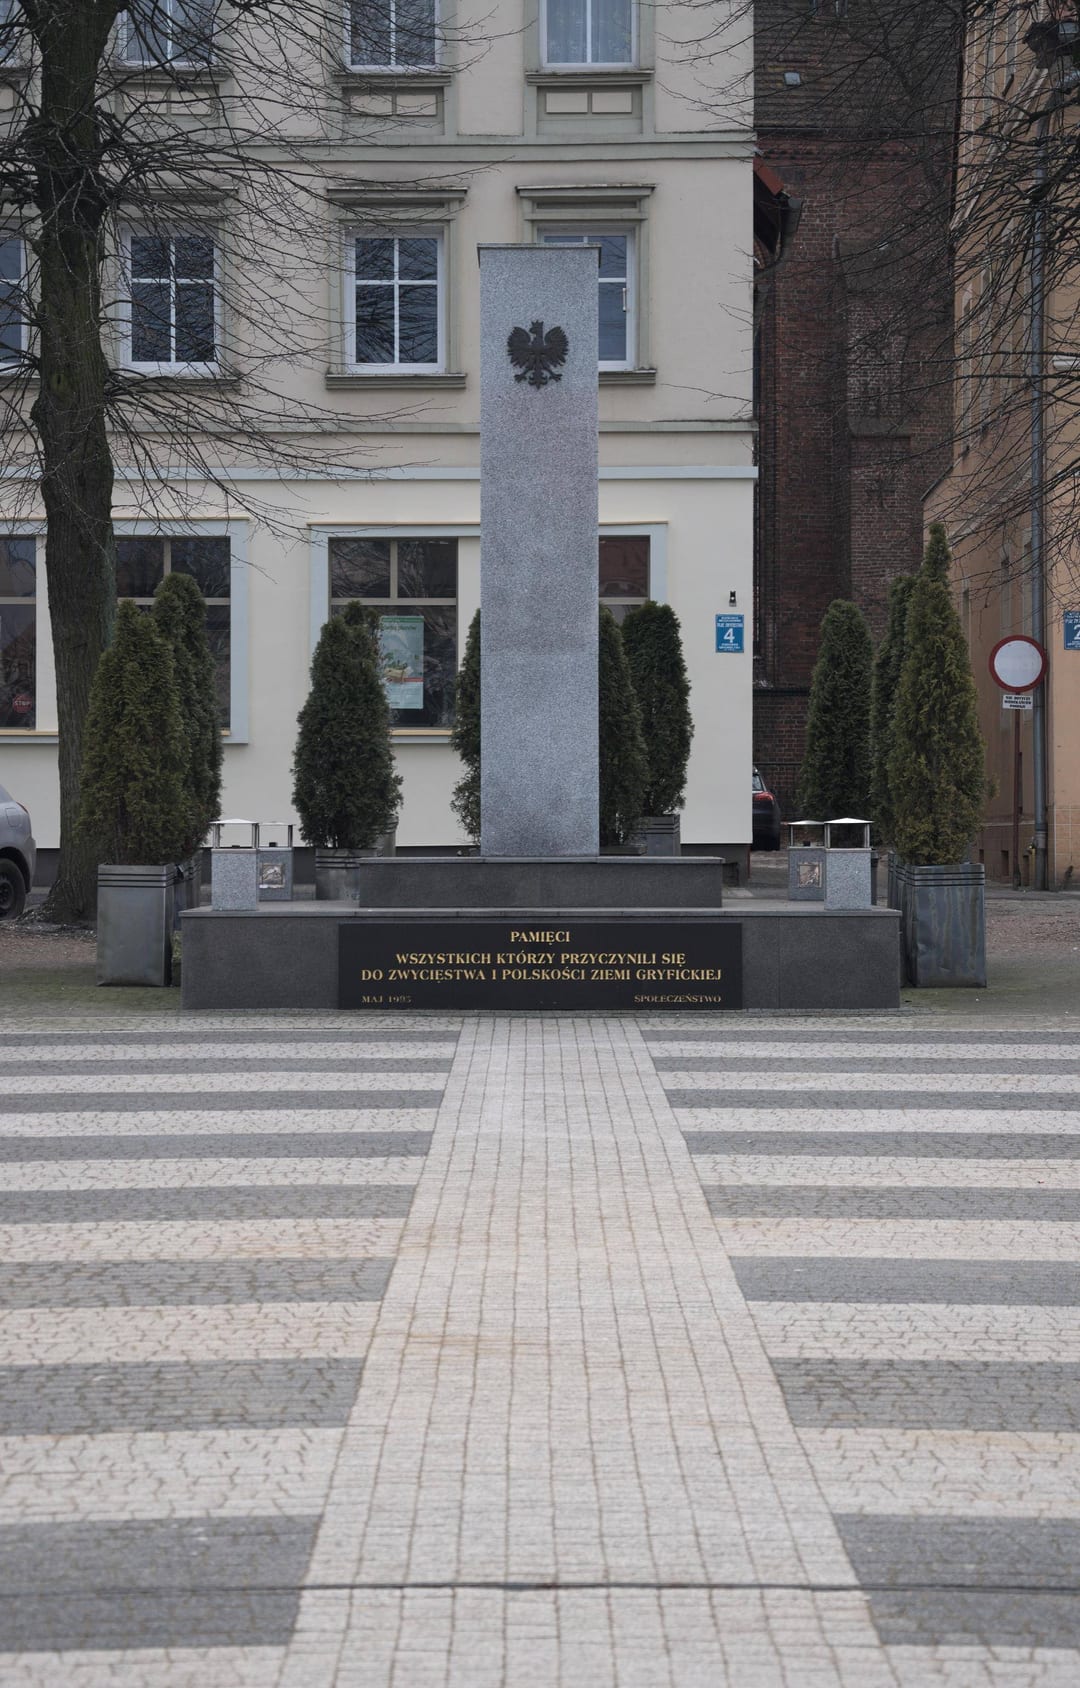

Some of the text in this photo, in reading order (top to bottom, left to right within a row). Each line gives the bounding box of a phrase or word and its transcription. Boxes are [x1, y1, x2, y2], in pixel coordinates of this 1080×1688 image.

[723, 628, 735, 643] 4
[510, 931, 570, 945] PAMIĘCI
[395, 949, 686, 966] WSZYSTKICH KTÓRZY PRZYCZYNILI SIĘ
[361, 966, 722, 983] DO ZWYCIĘSTWA I POLSKOŚCI ZIEMI GRYFICKIEJ
[361, 995, 383, 1003] MAJ
[634, 993, 722, 1003] SPOŁECZEŃSTWO
